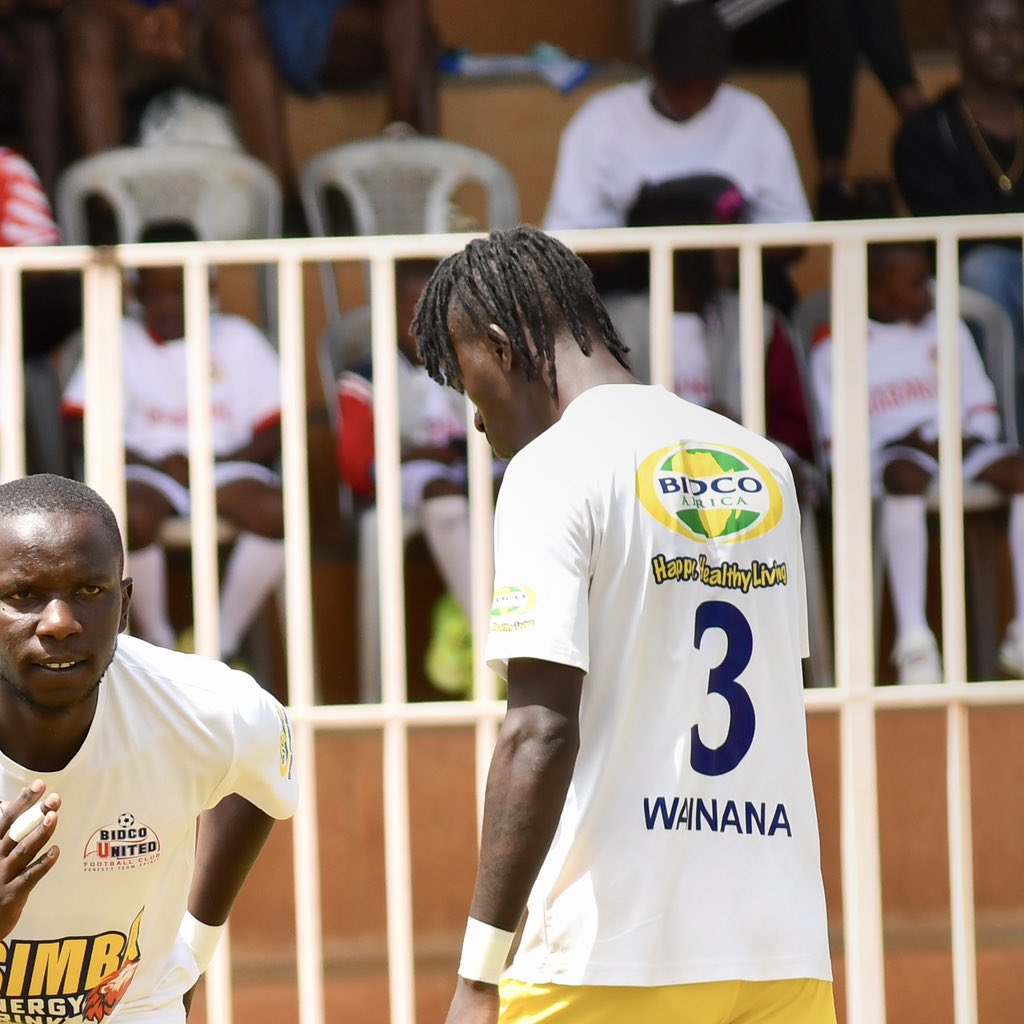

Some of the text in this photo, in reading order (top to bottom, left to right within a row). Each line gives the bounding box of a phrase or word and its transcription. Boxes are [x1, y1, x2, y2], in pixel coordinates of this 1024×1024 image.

[658, 476, 763, 496] BIDCO
[681, 496, 748, 509] ARICA
[751, 560, 788, 587] Living
[690, 599, 756, 777] 3
[643, 796, 793, 838] WAINANA
[100, 827, 148, 841] BIDCO
[97, 840, 157, 859] UNITED
[83, 859, 134, 868] FOOTBALL
